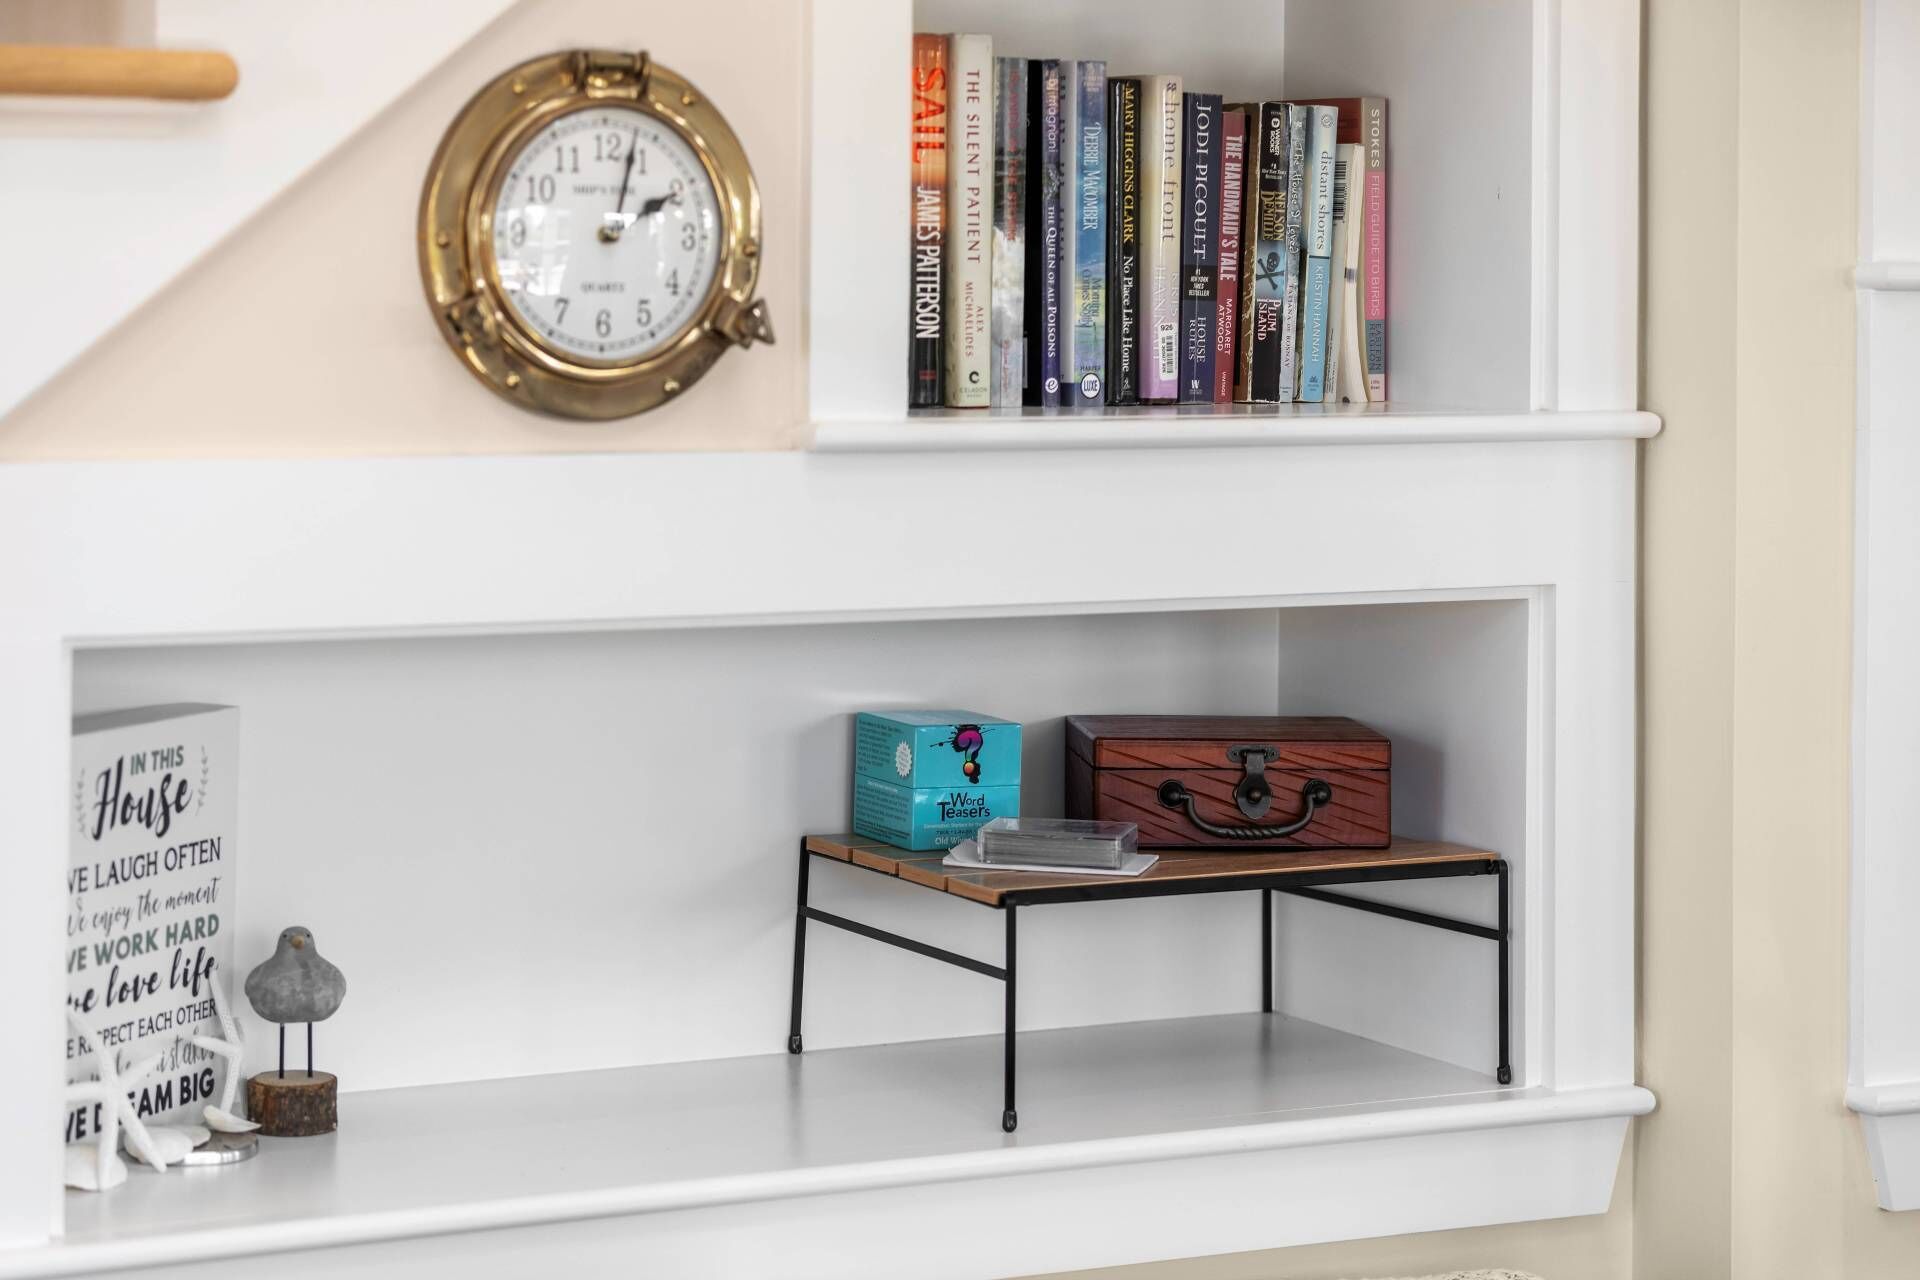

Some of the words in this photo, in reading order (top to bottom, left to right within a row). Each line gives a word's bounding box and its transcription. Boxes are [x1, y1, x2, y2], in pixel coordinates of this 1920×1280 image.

[966, 70, 980, 103] THE
[1124, 87, 1136, 129] MARY
[912, 67, 945, 164] SAIL
[1046, 95, 1058, 153] magnani
[1164, 102, 1180, 168] home
[1196, 102, 1212, 154] JODI
[556, 146, 579, 173] 11
[595, 133, 621, 162] 12
[966, 113, 980, 176] SILENT
[1082, 122, 1102, 165] DEBBIE
[1225, 135, 1243, 160] THE
[1371, 108, 1380, 168] STOKES
[638, 148, 646, 174] 1
[1123, 131, 1135, 192] HIGGINS
[1319, 150, 1333, 198] distant
[528, 174, 556, 203] 10
[669, 178, 684, 206] 2
[1081, 170, 1100, 232] MACOMBER
[1221, 162, 1241, 249] HANDMAID'S
[1290, 172, 1303, 205] House
[1371, 175, 1380, 210] FIELD
[510, 218, 526, 247] 9
[916, 186, 941, 241] JAMES
[966, 187, 981, 264] PATIENT
[1047, 205, 1056, 225] THE
[1123, 195, 1134, 243] CLARK
[1162, 180, 1178, 242] front
[1193, 163, 1209, 260] PICOULT
[1273, 190, 1286, 241] NELSON
[1316, 203, 1330, 251] shores
[681, 223, 696, 251] 3
[1045, 227, 1057, 269] QUEEN
[1371, 214, 1380, 257] GUIDE
[665, 268, 679, 296] 4
[1048, 272, 1056, 285] OF
[1123, 255, 1134, 275] No
[1219, 250, 1239, 282] TALE
[1371, 258, 1380, 274] TO
[915, 245, 941, 339] PATTERSON
[1047, 287, 1056, 303] ALL
[1122, 276, 1133, 307] Place
[1313, 264, 1325, 310] KRISTIN
[1370, 277, 1380, 317] BIRDS
[554, 299, 570, 325] 7
[595, 310, 612, 338] 6
[637, 299, 651, 327] 5
[965, 281, 975, 358] MICHAELIDES
[976, 305, 985, 333] ALEX
[1047, 306, 1057, 358] POISONS
[1121, 309, 1133, 334] Like
[1216, 304, 1225, 352] ATWOOD
[1223, 298, 1233, 356] MARGARET
[1256, 298, 1267, 341] ISLAND
[1267, 299, 1282, 332] PLUM
[1121, 337, 1133, 372] Home
[1188, 319, 1197, 361] RULES
[1196, 316, 1207, 364] HOUSE
[1311, 313, 1322, 362] HANNAH
[1083, 378, 1099, 393] LUXE
[130, 752, 147, 776] IN
[151, 744, 184, 772] THIS
[91, 755, 193, 841] House
[936, 801, 991, 822] Teasers
[950, 791, 985, 807] Word
[94, 850, 158, 890] LAUGH
[164, 836, 221, 872] OFTEN
[92, 906, 131, 938] enjoy
[136, 888, 161, 921] the
[165, 876, 222, 911] moment
[94, 927, 159, 966] WORK
[165, 913, 220, 948] HARD
[106, 964, 162, 1007] love
[169, 946, 218, 998] life
[79, 1021, 135, 1058] RPECT
[138, 1010, 173, 1038] EACH
[176, 998, 217, 1026] OTHER
[94, 1079, 173, 1134] DAM
[179, 1067, 215, 1106] BIG
